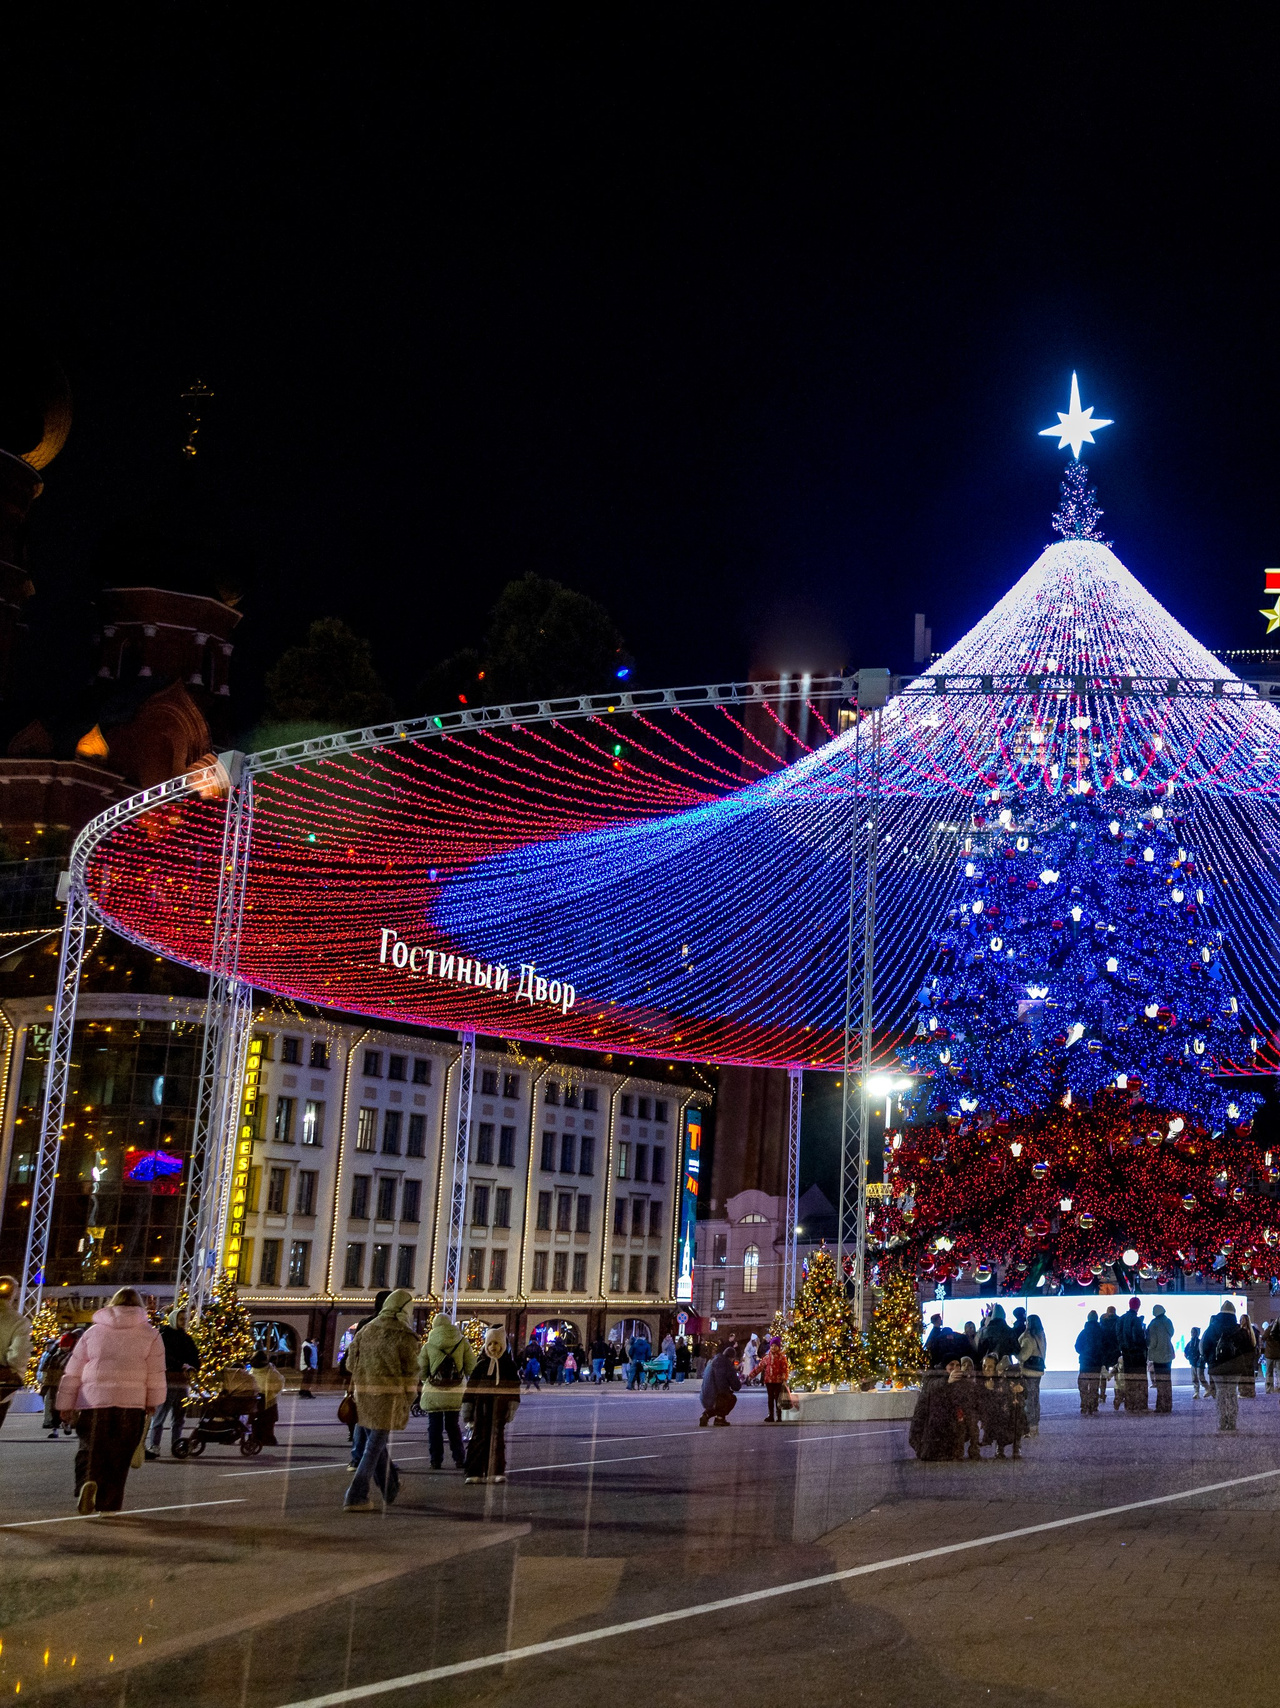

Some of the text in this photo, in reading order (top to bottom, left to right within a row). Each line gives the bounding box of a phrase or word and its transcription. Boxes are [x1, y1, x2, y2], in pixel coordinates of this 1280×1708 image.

[379, 927, 576, 1015] Гостиный Двор
[226, 1040, 262, 1281] HOTEL RESTAURANT
